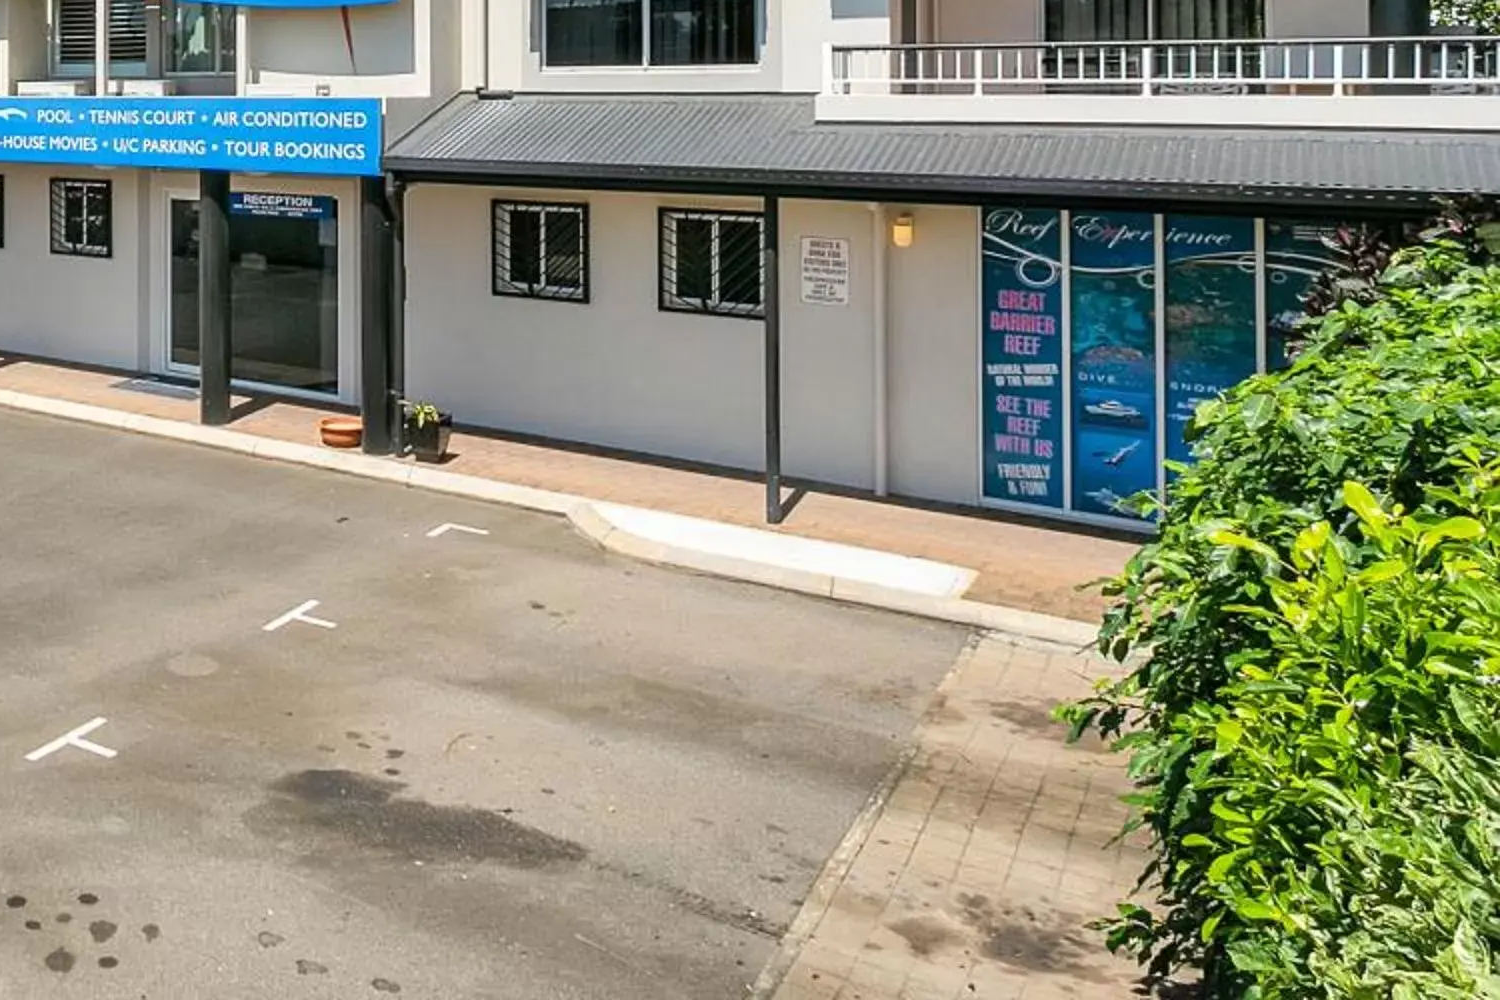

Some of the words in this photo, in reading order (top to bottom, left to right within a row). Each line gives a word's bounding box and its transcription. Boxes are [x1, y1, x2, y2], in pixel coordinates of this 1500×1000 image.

[36, 109, 74, 124] POOL
[90, 109, 140, 126] TENNIS
[142, 110, 196, 126] COURT
[212, 110, 239, 127] AIR
[242, 111, 368, 129] CONDITIONED
[49, 135, 98, 152] MOVIES
[142, 138, 207, 156] PARKING
[223, 139, 271, 158] TOUR
[274, 141, 366, 161] BOOKINGS
[243, 193, 314, 207] RECEPTION
[985, 209, 1058, 242] Reef
[998, 289, 1047, 312] GREAT
[990, 311, 1056, 335] BARRIER
[1004, 334, 1041, 355] REEF
[1078, 370, 1116, 385] DIVE
[996, 394, 1021, 415] SEE
[1026, 398, 1052, 419] THE
[1007, 415, 1041, 436] REEF
[994, 433, 1030, 455] WITH
[1034, 439, 1054, 459] US
[997, 463, 1051, 480] FRIENDLY
